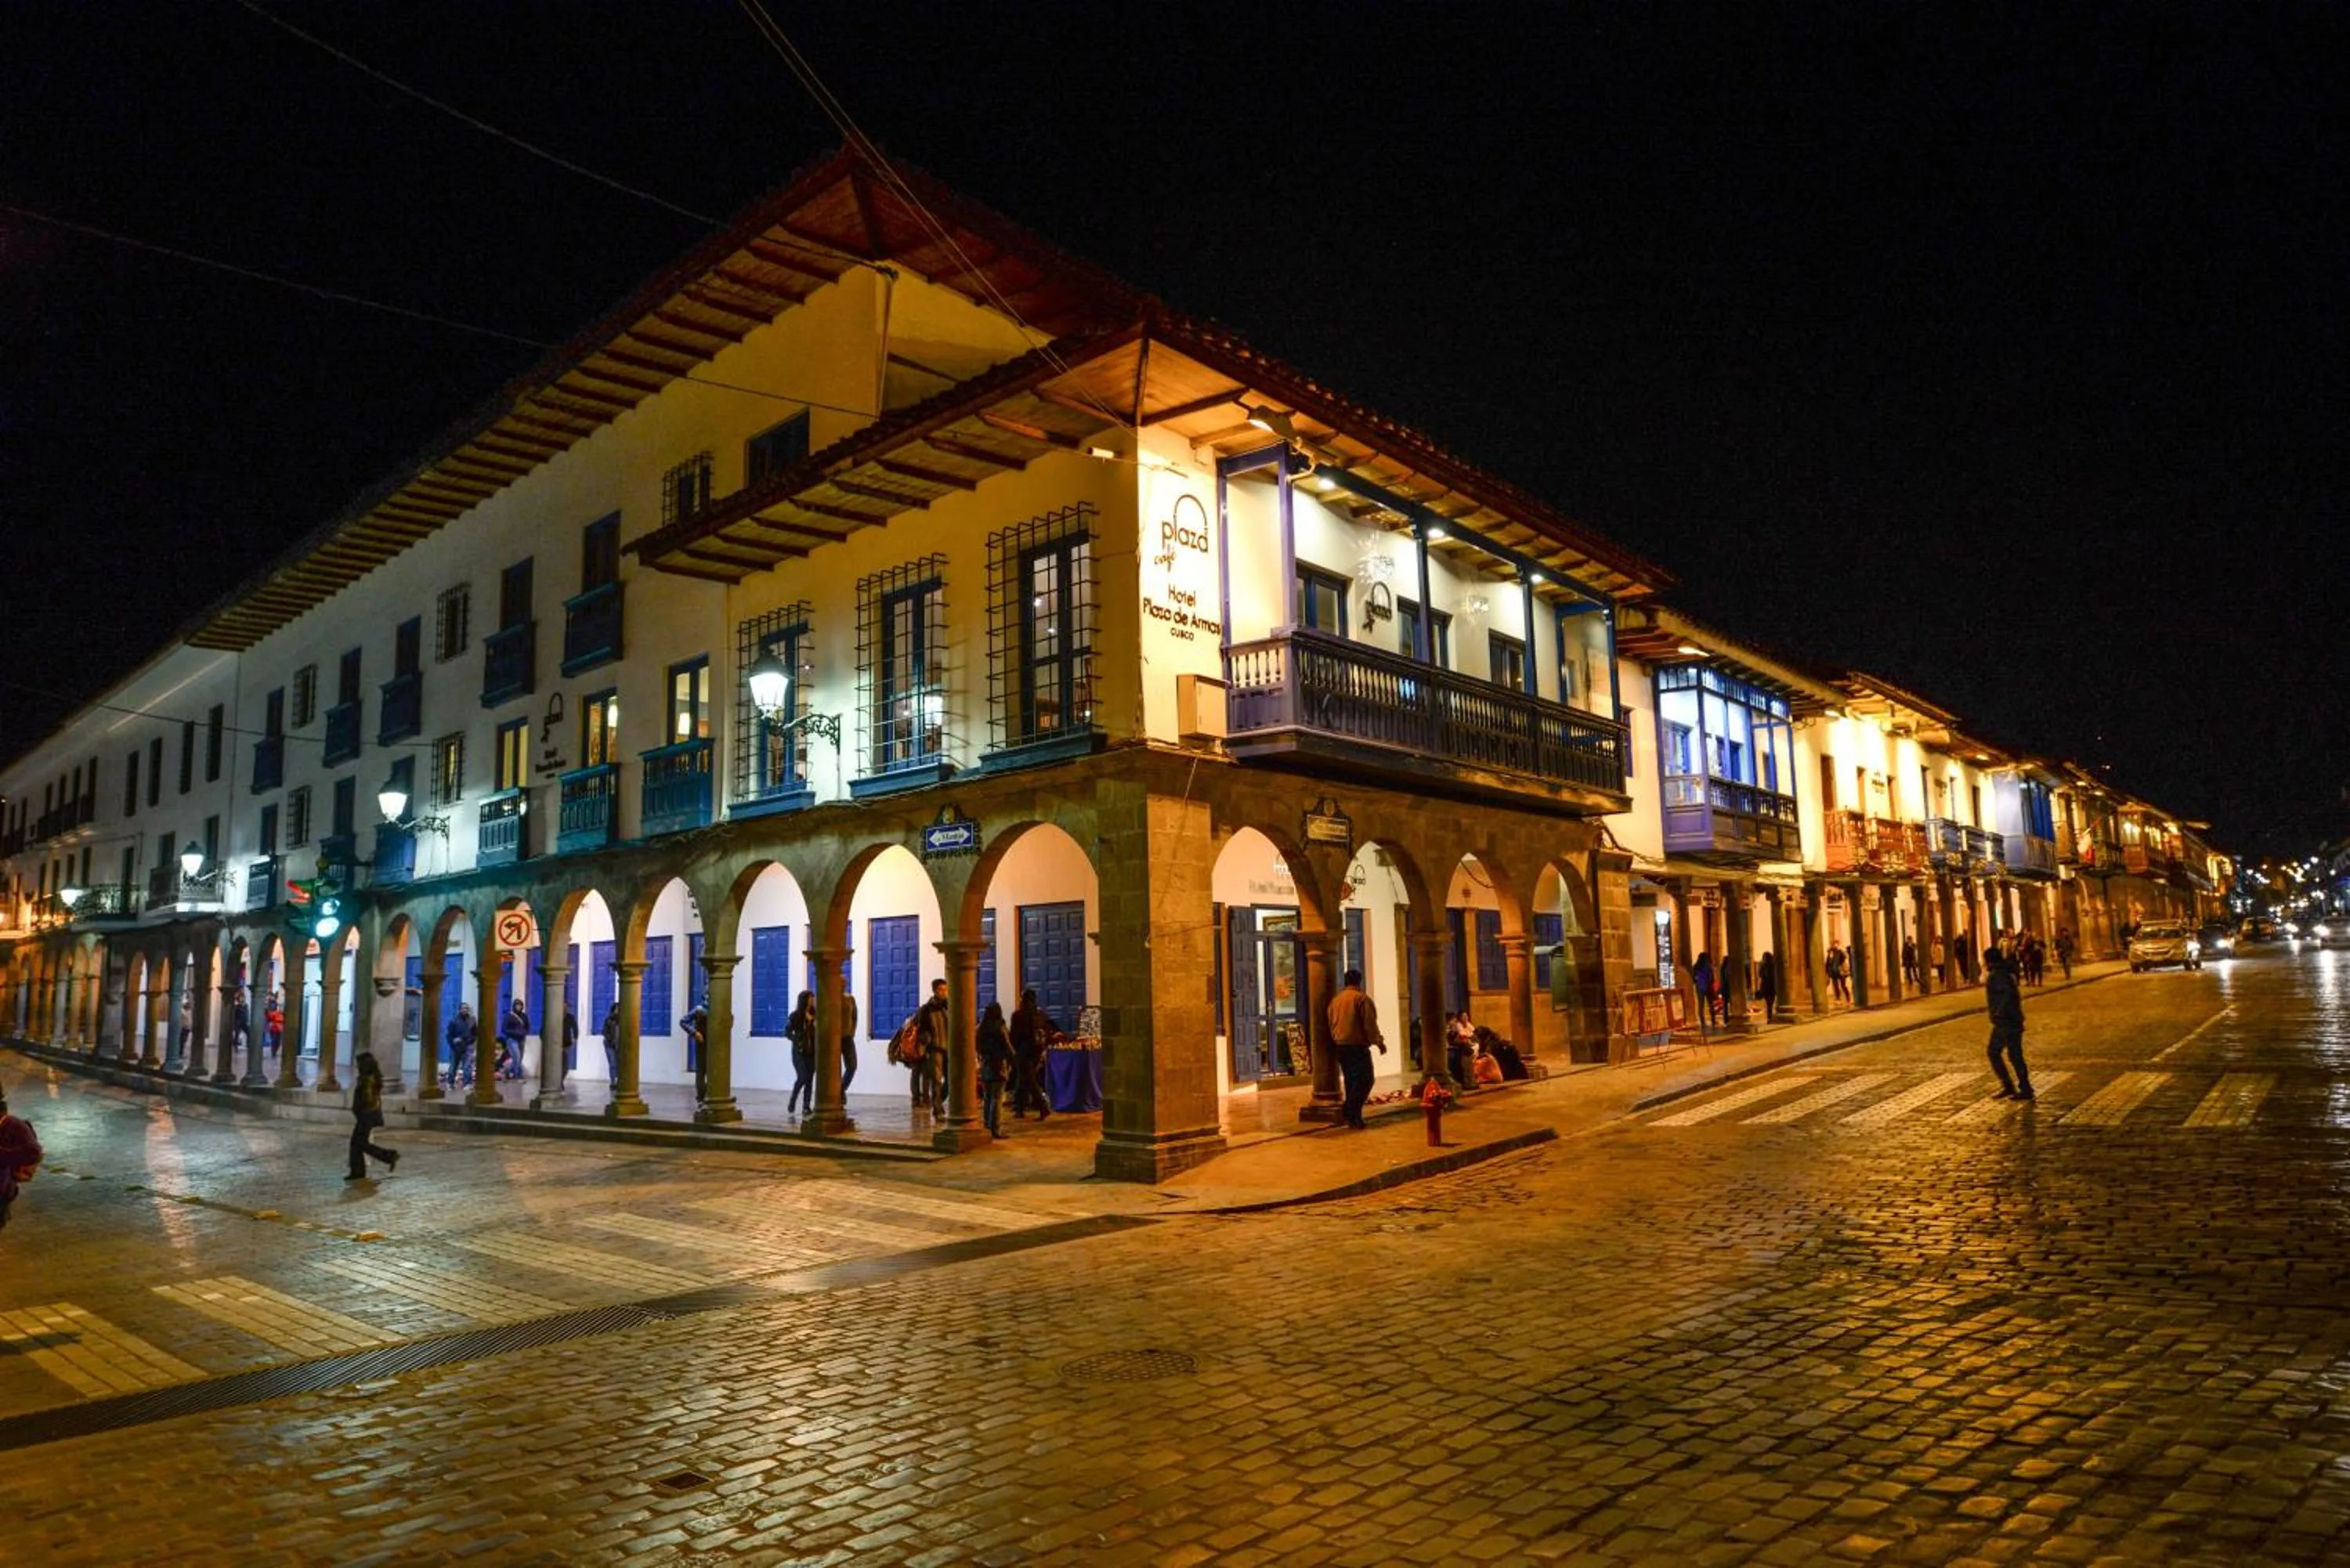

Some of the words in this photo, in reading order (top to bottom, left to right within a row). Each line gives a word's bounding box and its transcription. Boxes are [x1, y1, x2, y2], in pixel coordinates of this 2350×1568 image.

[1161, 511, 1209, 553] plaza
[1168, 583, 1196, 607] Hotel
[1143, 597, 1172, 622] Plaza
[1173, 606, 1189, 626] de
[1191, 612, 1222, 636] Armas
